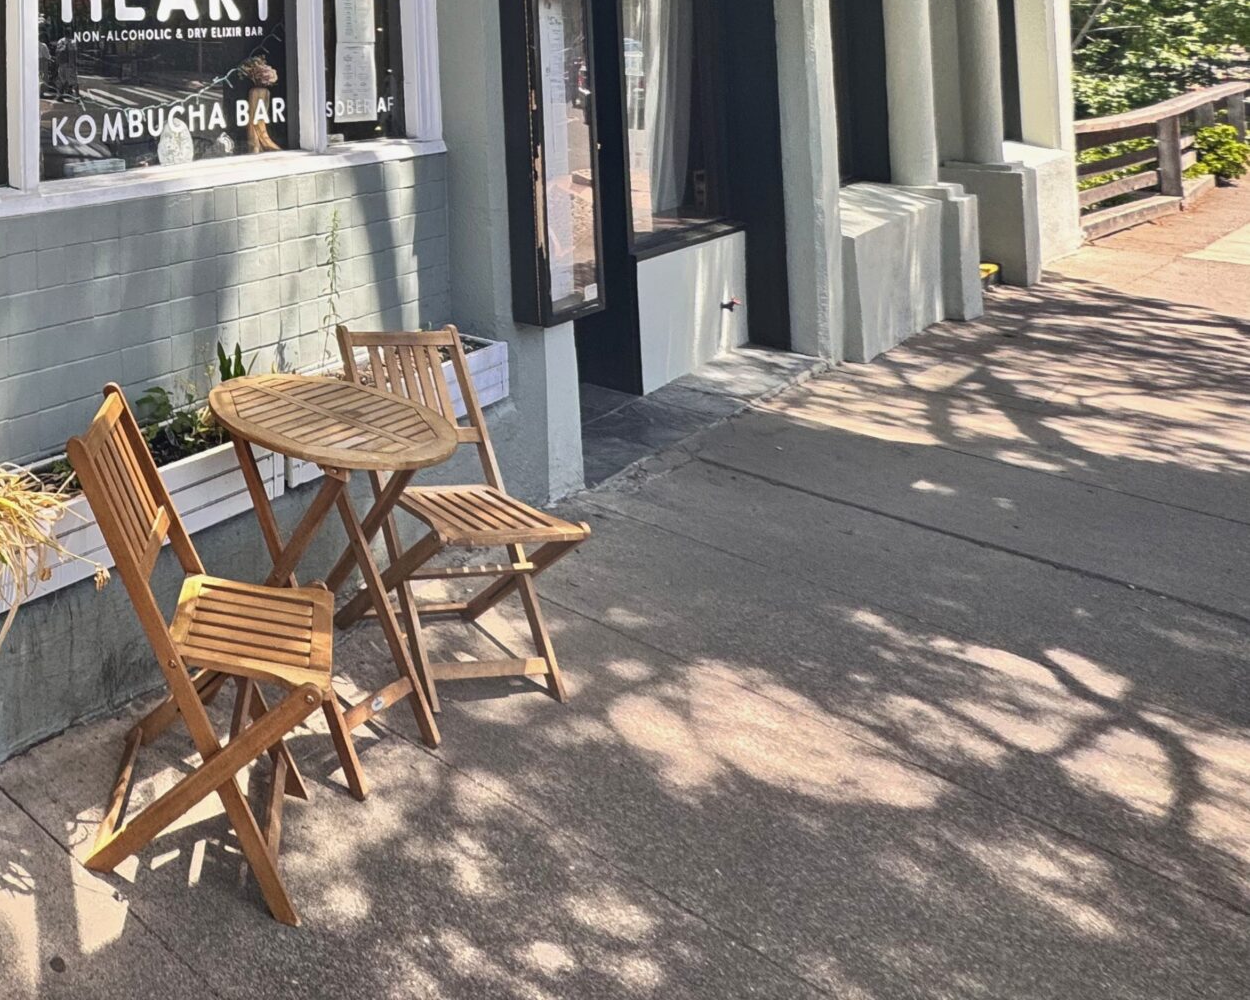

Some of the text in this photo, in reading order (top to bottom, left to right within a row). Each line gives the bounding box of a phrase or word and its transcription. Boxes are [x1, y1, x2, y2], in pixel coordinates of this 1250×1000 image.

[73, 26, 263, 43] NON-ALCOHOLIC & DRY ELIXIR BAR
[326, 96, 394, 117] SOBER AF
[51, 98, 286, 147] KOMBUCHA BAR
